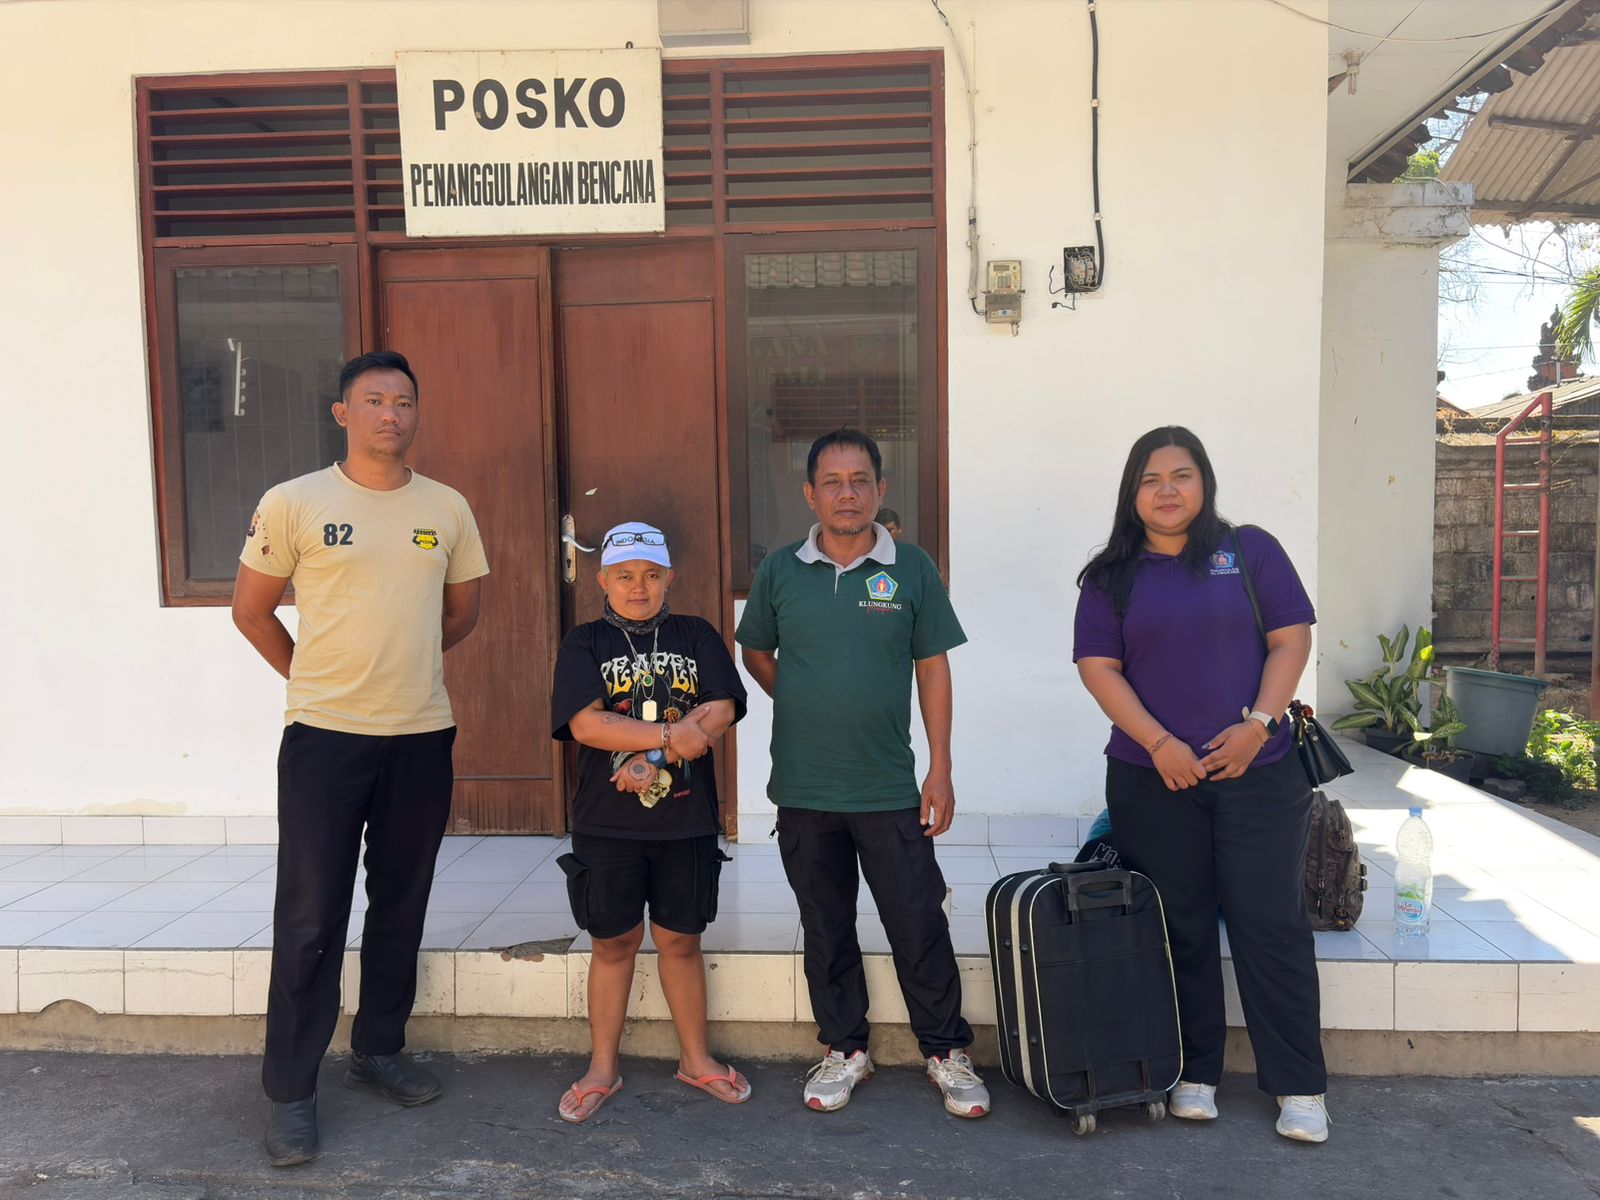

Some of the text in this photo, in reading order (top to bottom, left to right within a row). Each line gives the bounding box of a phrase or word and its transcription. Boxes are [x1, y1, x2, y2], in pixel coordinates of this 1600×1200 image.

[432, 77, 626, 131] POSKO
[410, 159, 656, 207] PENANGGULANGAN BENCANA
[323, 523, 354, 546] 82
[615, 535, 656, 545] INDOSIA
[858, 600, 902, 610] KLUNGKUNG
